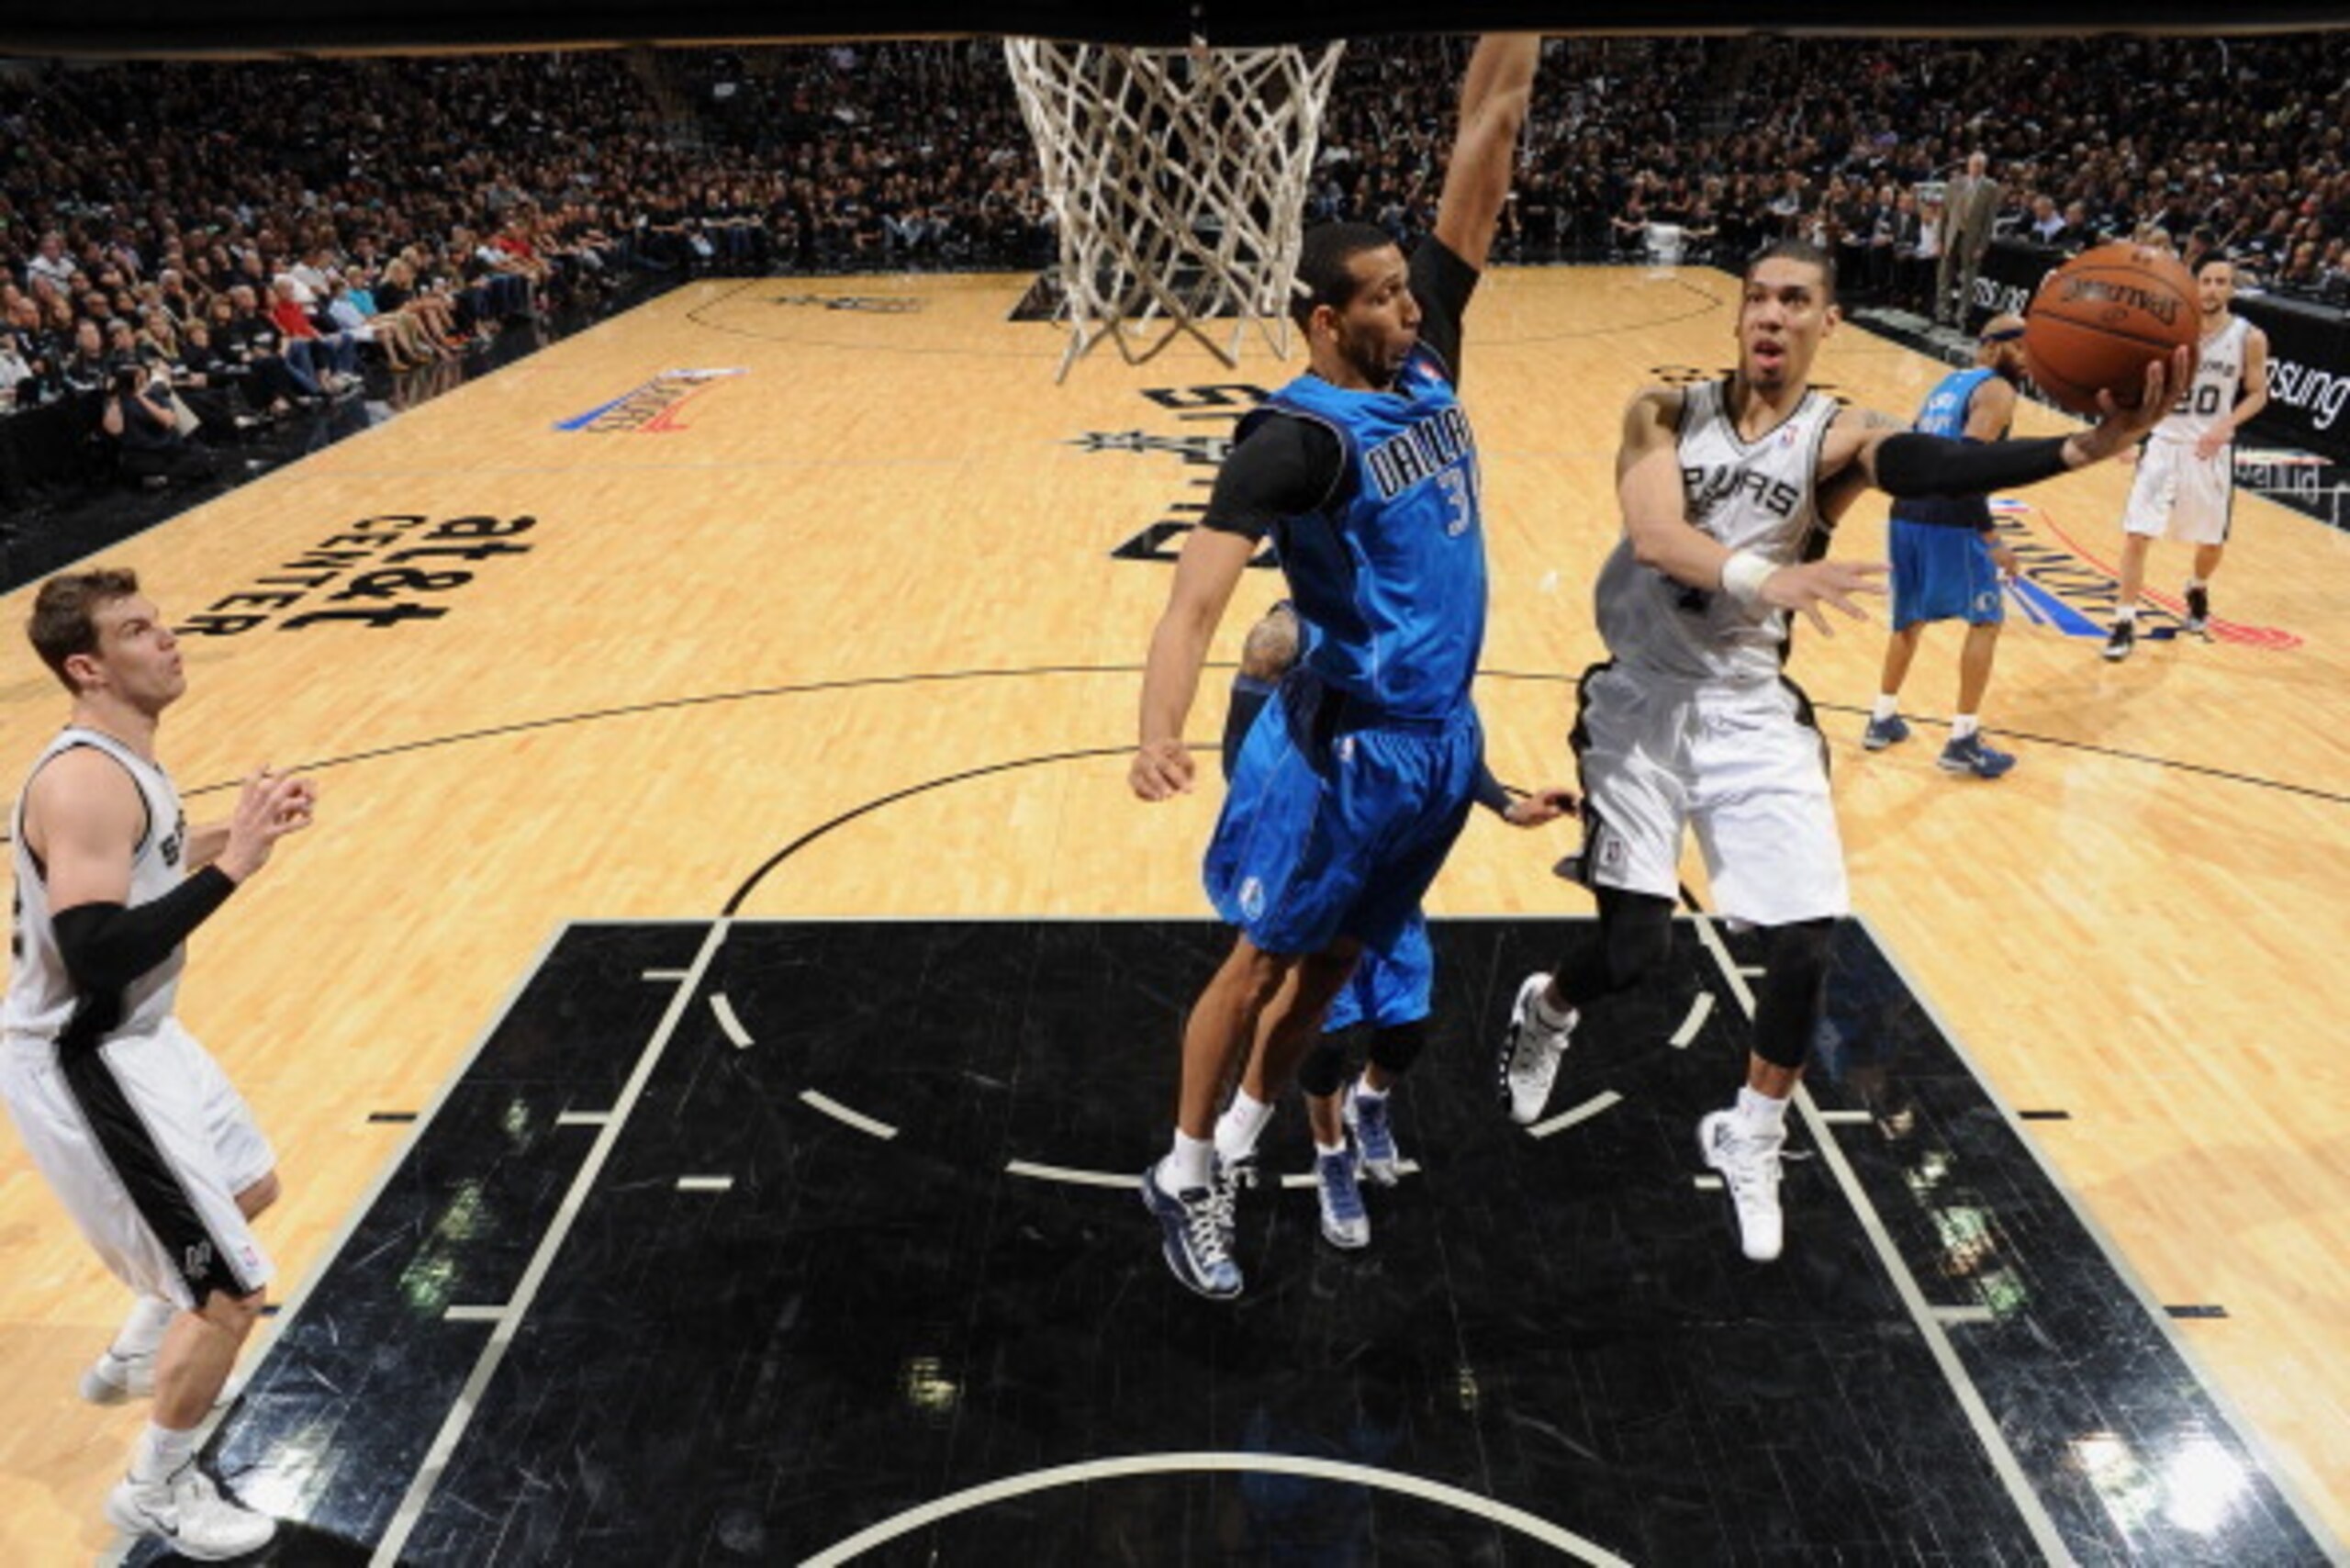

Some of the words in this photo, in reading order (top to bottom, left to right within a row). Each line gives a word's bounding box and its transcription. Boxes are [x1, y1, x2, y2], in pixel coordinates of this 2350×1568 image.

[2266, 355, 2350, 431] sung
[1363, 404, 1473, 503] DALLA
[172, 515, 428, 635] CENTER
